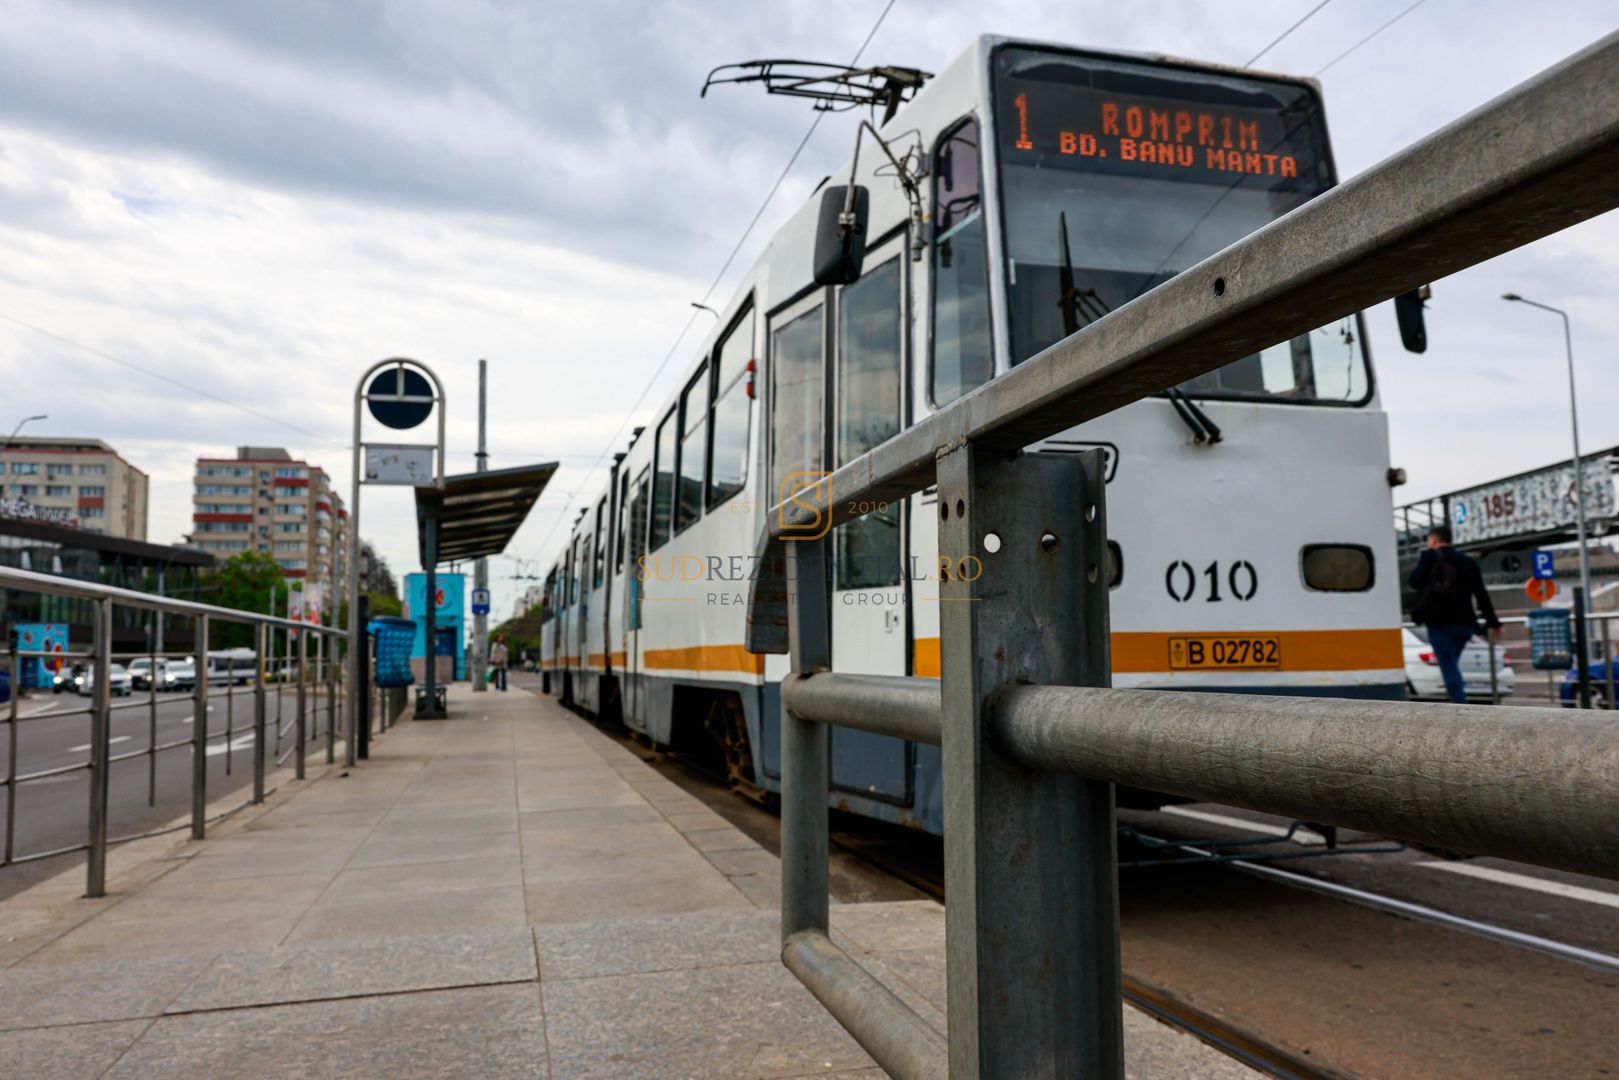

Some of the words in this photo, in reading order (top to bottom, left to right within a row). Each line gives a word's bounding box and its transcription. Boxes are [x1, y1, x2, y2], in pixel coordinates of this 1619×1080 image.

[1014, 93, 1033, 149] 1
[1102, 102, 1258, 151] ROMPRIM
[1060, 131, 1107, 158] BD.
[1120, 138, 1194, 167] BANU
[1206, 148, 1297, 178] MANTA
[1484, 491, 1516, 520] 185
[1165, 560, 1258, 602] 010
[1188, 641, 1205, 664] B
[1212, 640, 1278, 664] 02782
